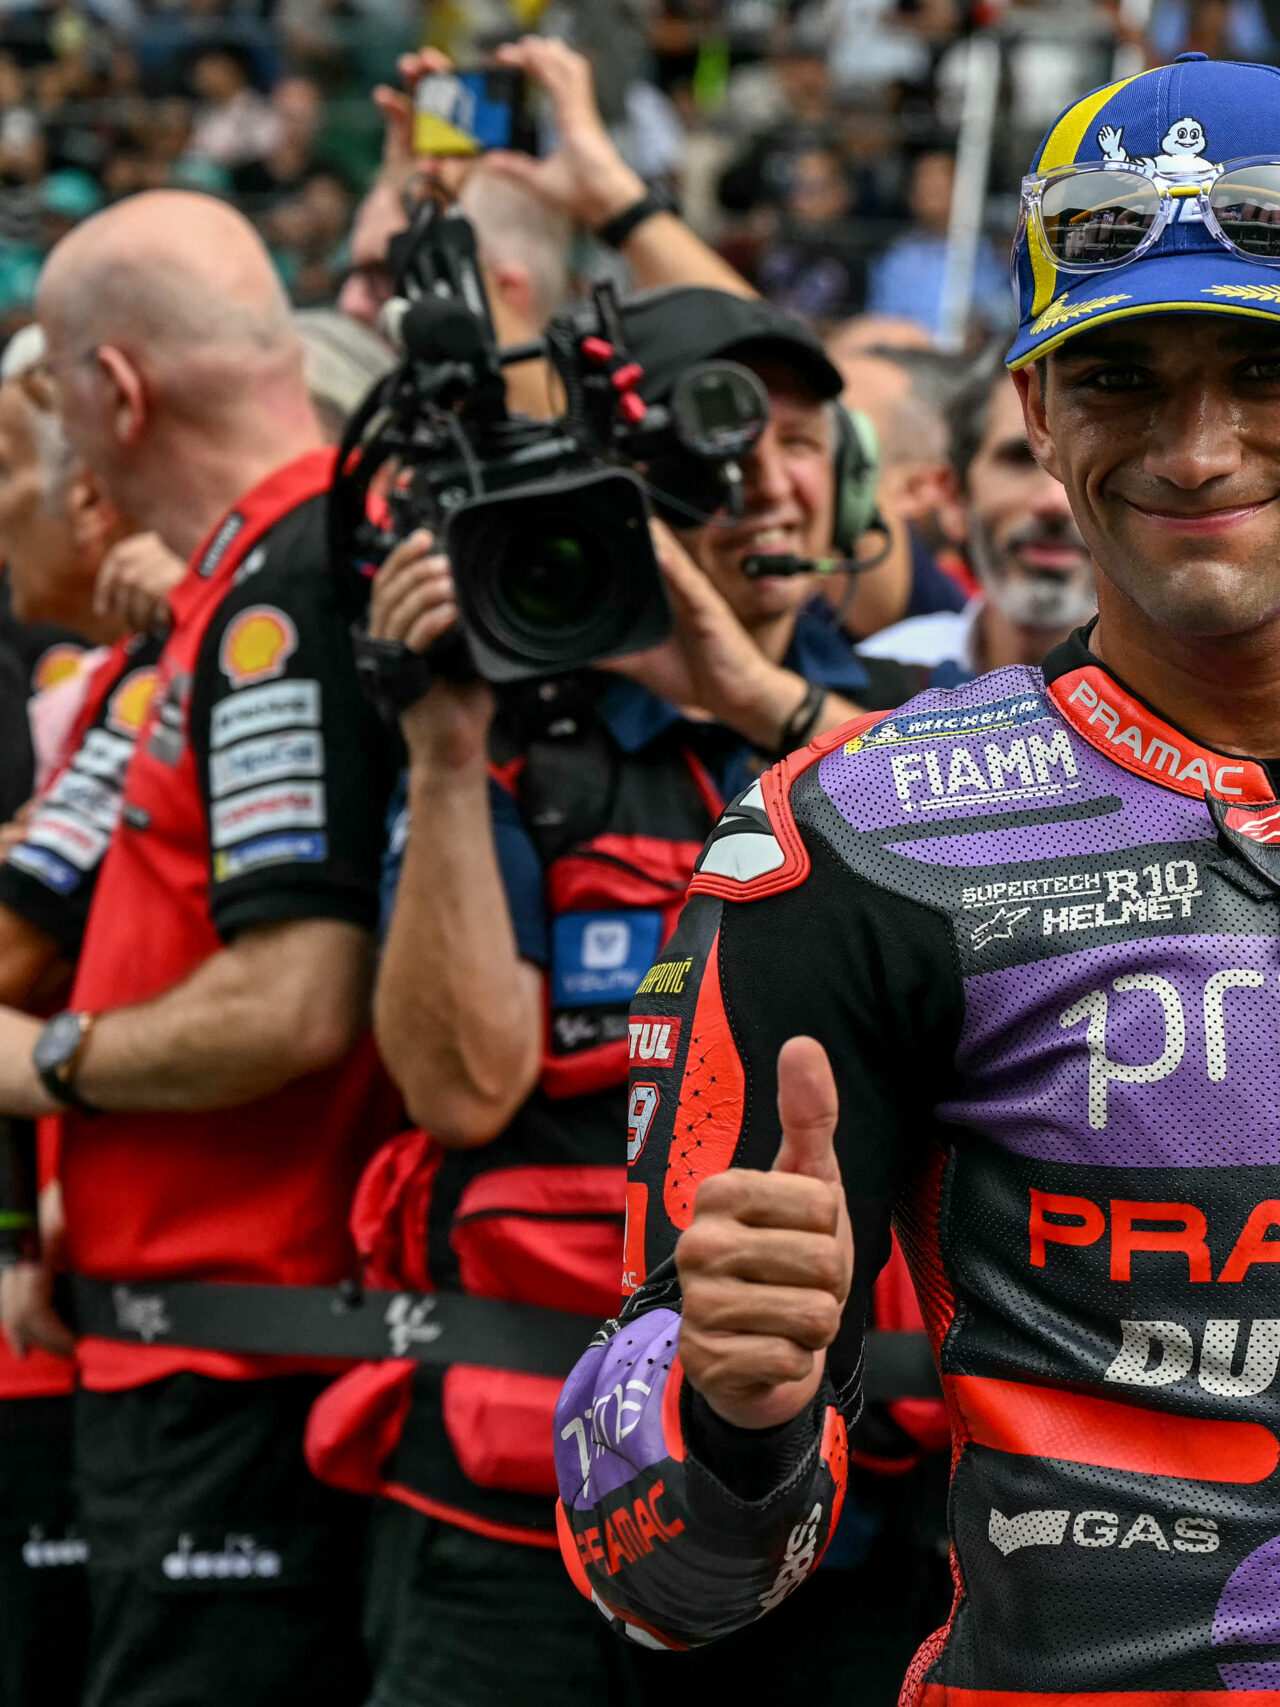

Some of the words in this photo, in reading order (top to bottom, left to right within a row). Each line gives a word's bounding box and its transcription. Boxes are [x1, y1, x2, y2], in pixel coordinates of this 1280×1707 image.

[907, 700, 1039, 734] MICHELIN
[1068, 679, 1245, 796] PRAMAC
[891, 729, 1078, 800] FIAMM
[962, 873, 1101, 903] SUPERTECH
[1103, 859, 1199, 903] R10
[1043, 890, 1202, 936] HELMET
[627, 1023, 672, 1060] TUL
[1072, 1510, 1220, 1553] GAS
